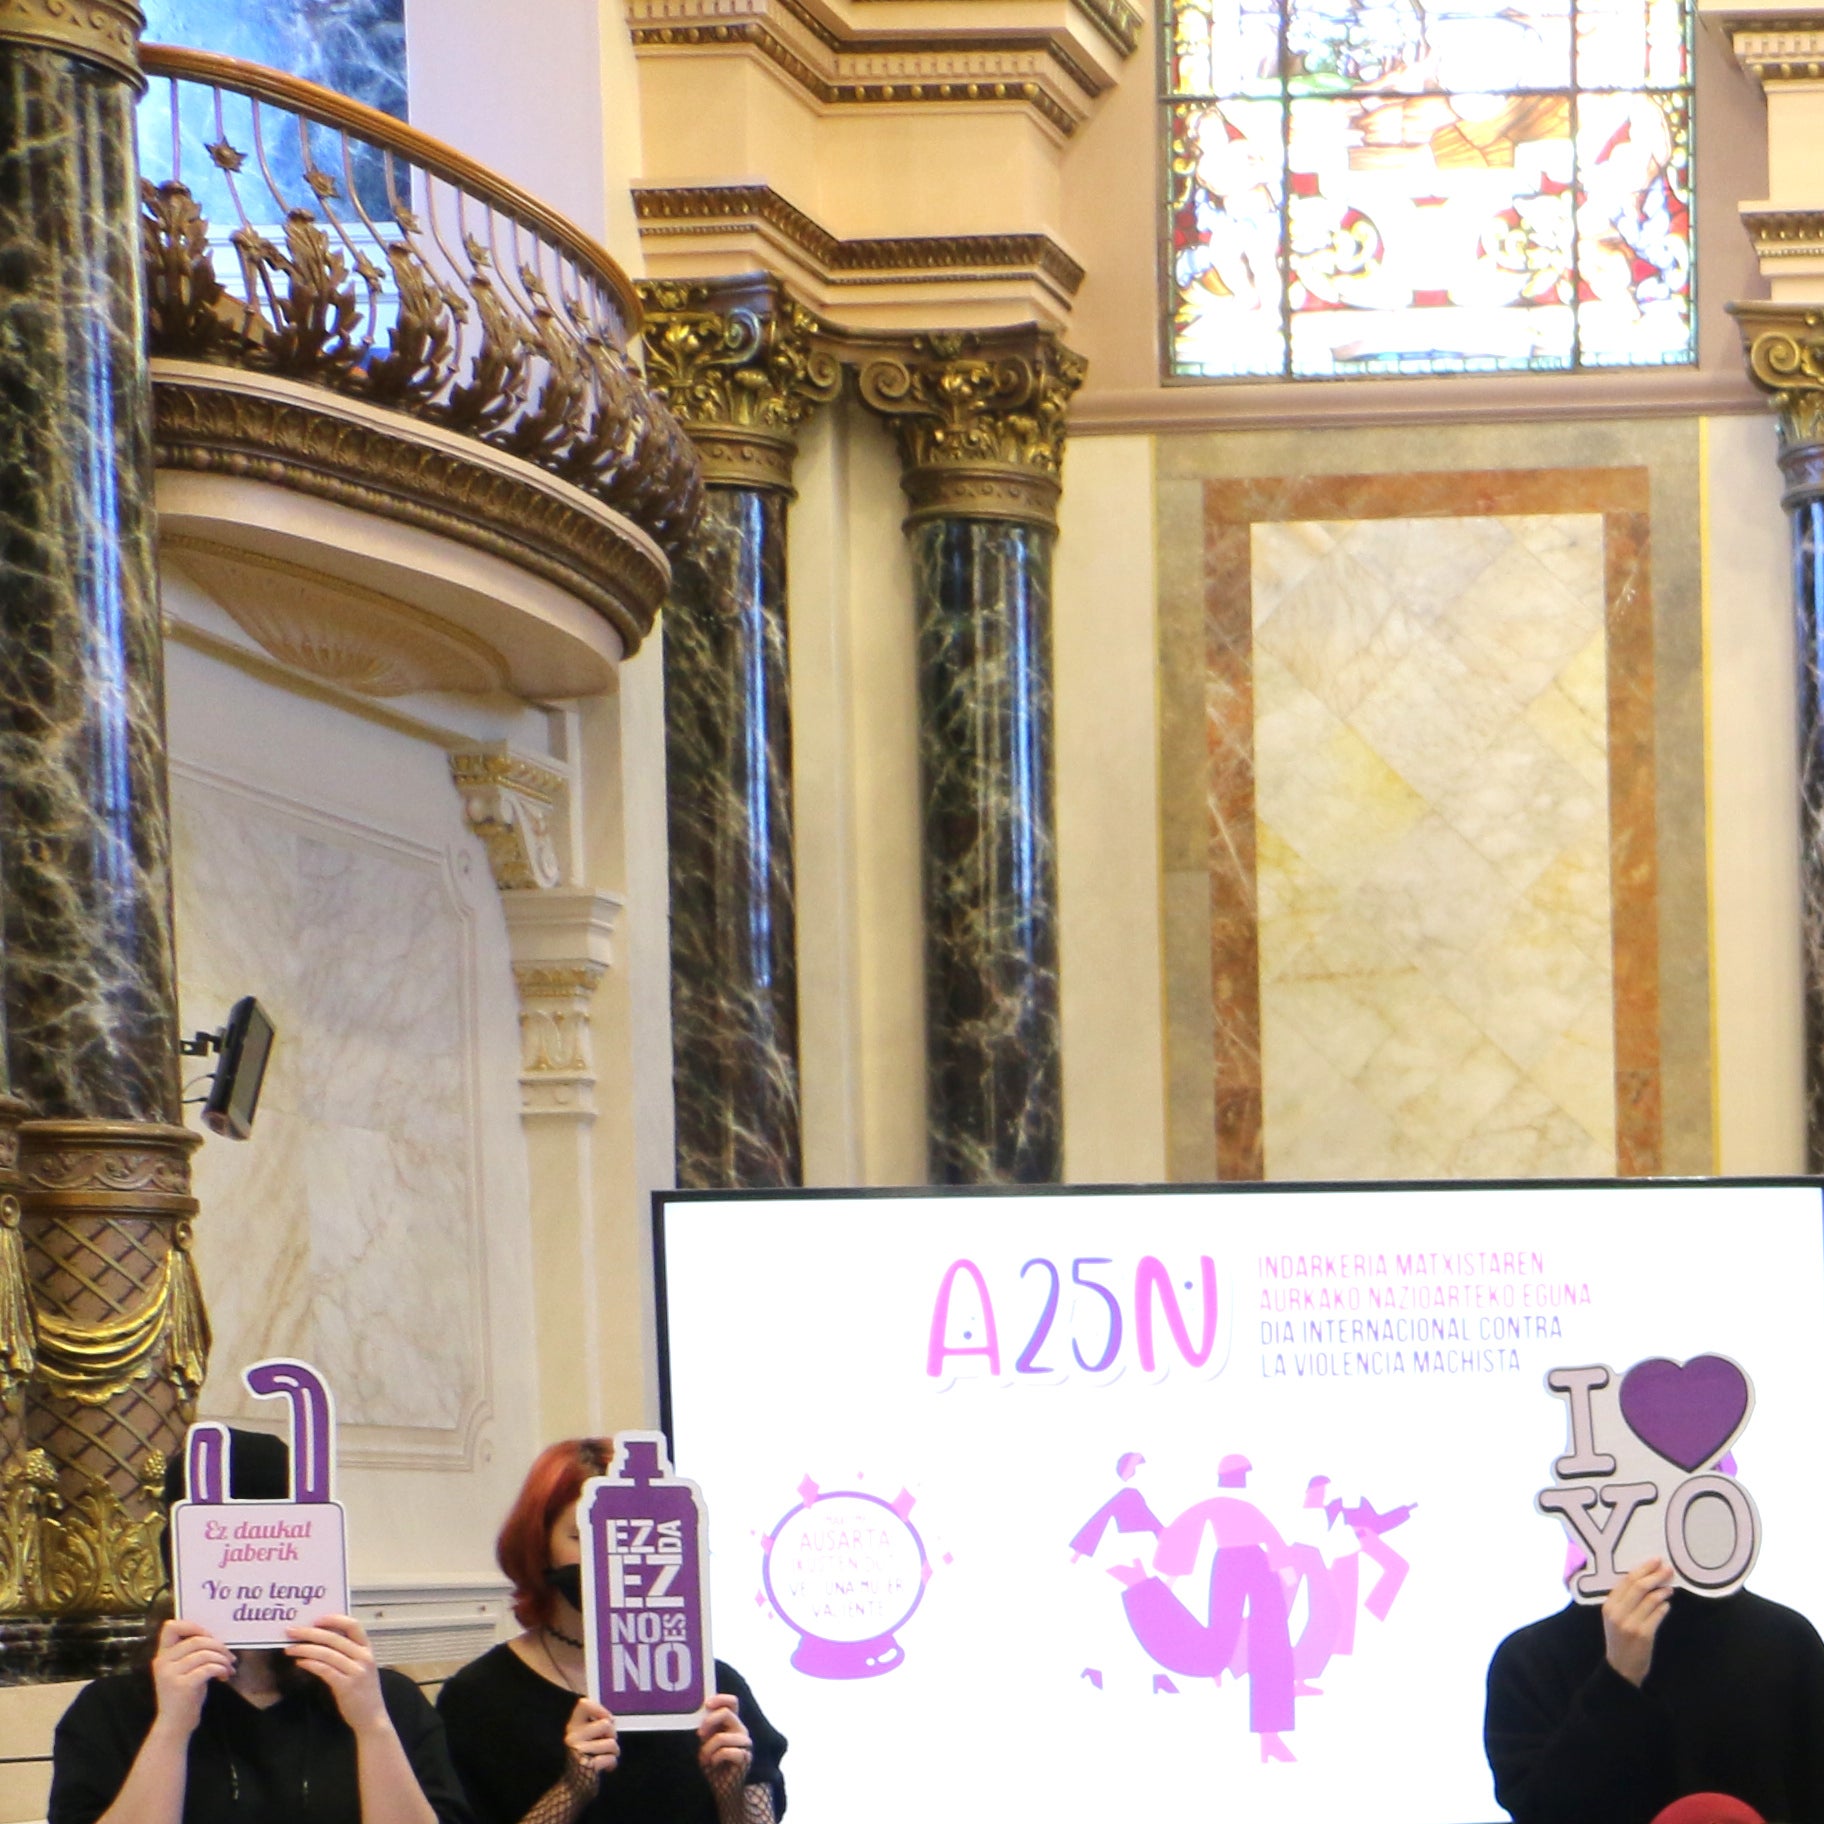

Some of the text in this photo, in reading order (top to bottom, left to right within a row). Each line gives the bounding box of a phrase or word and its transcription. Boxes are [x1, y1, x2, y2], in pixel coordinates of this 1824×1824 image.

[1258, 1251, 1543, 1280] INDARKERIA MATXISTAREN
[1261, 1283, 1591, 1312] AURKAKO NAZIOARTEKO EGUNA
[927, 1255, 1218, 1377] A25N
[1262, 1315, 1562, 1345] DIA INTERNACIONAL CONTRA
[1262, 1348, 1520, 1378] LA VIOLENCIA MACHISTA
[1547, 1366, 1616, 1480] I
[204, 1519, 312, 1541] Ez daukat
[606, 1519, 683, 1554] EZ DA
[1538, 1475, 1755, 1598] YO
[218, 1543, 299, 1568] jaberik
[202, 1580, 327, 1605] Yo no tengo
[608, 1554, 685, 1608] EZ
[232, 1603, 299, 1621] dueño
[610, 1612, 686, 1643] NO ES
[611, 1642, 692, 1692] NO
